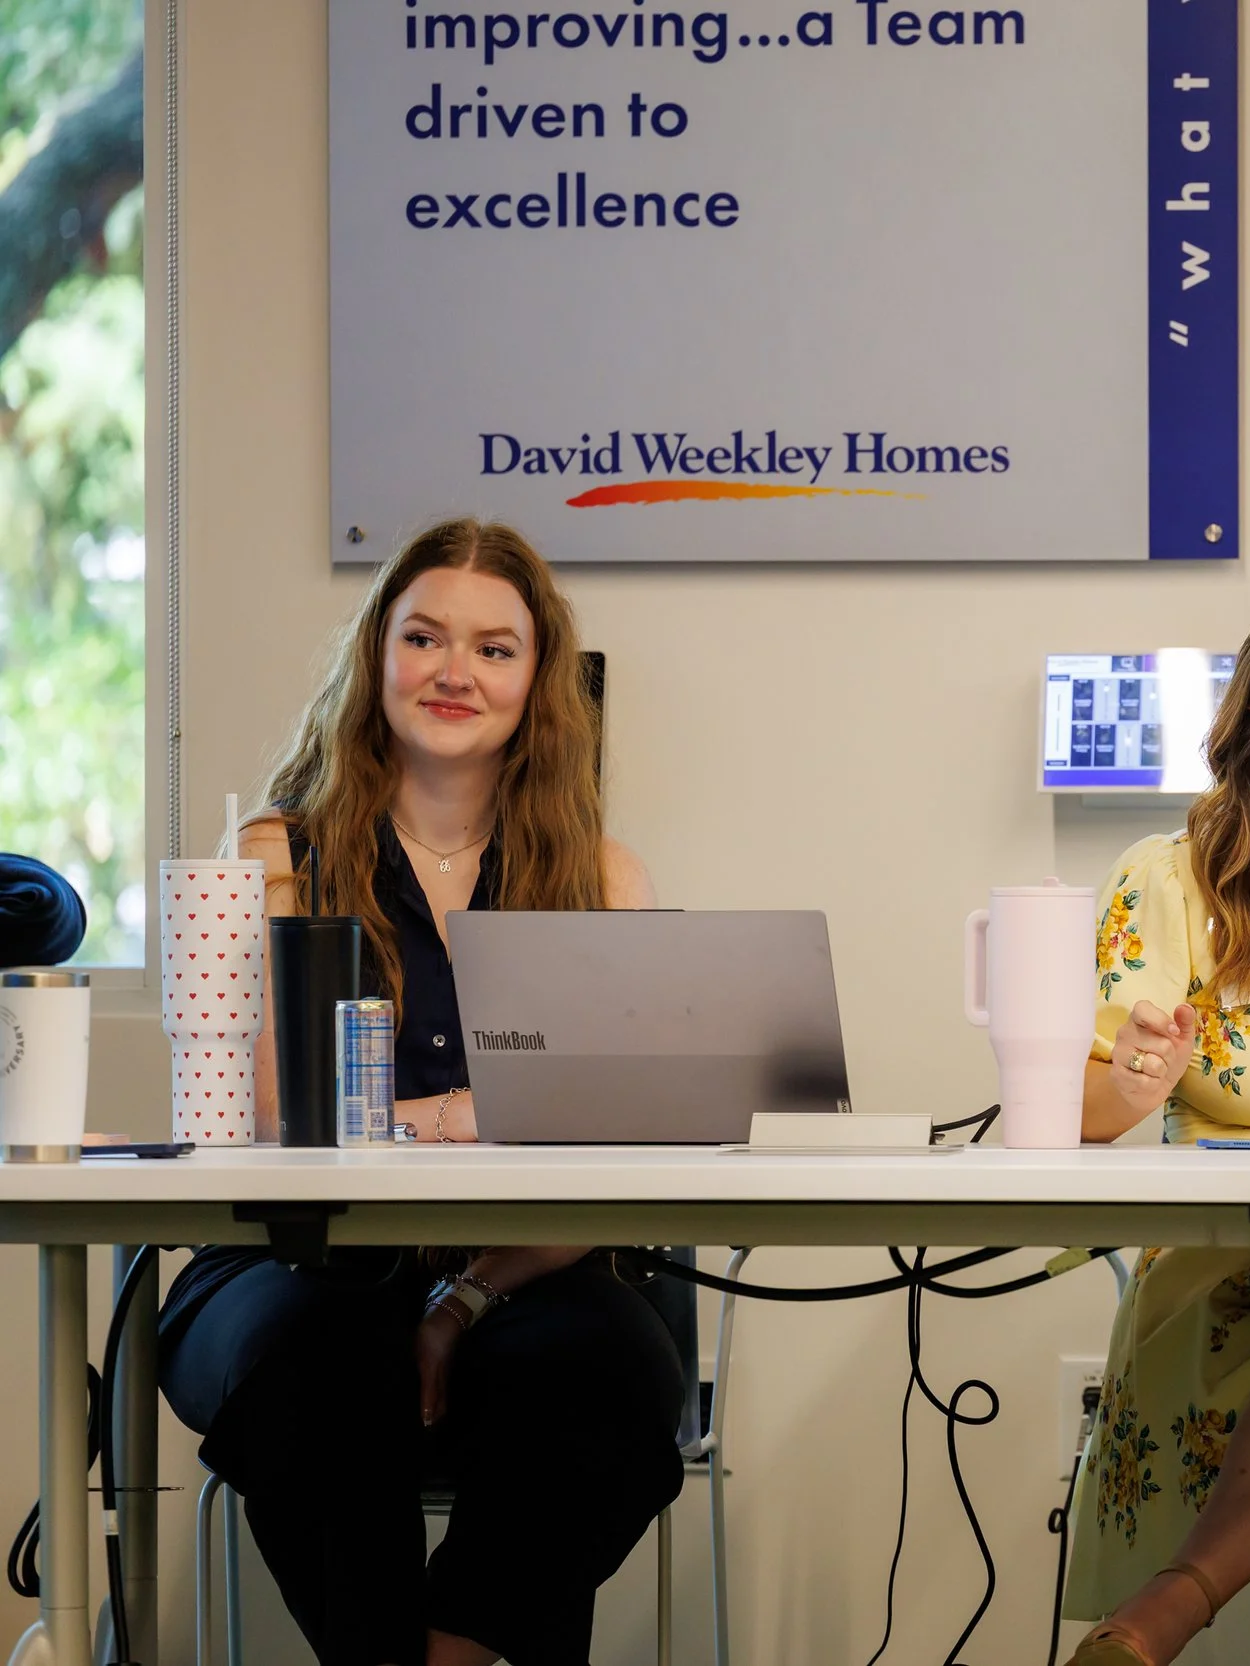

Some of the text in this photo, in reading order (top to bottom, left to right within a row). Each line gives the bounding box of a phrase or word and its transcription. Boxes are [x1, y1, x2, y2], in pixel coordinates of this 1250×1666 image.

[855, 0, 1025, 46] Team
[405, 82, 689, 139] driven to
[405, 171, 739, 229] excellence
[478, 430, 1010, 484] David Weekley Homes
[471, 1030, 547, 1051] ThinkBook
